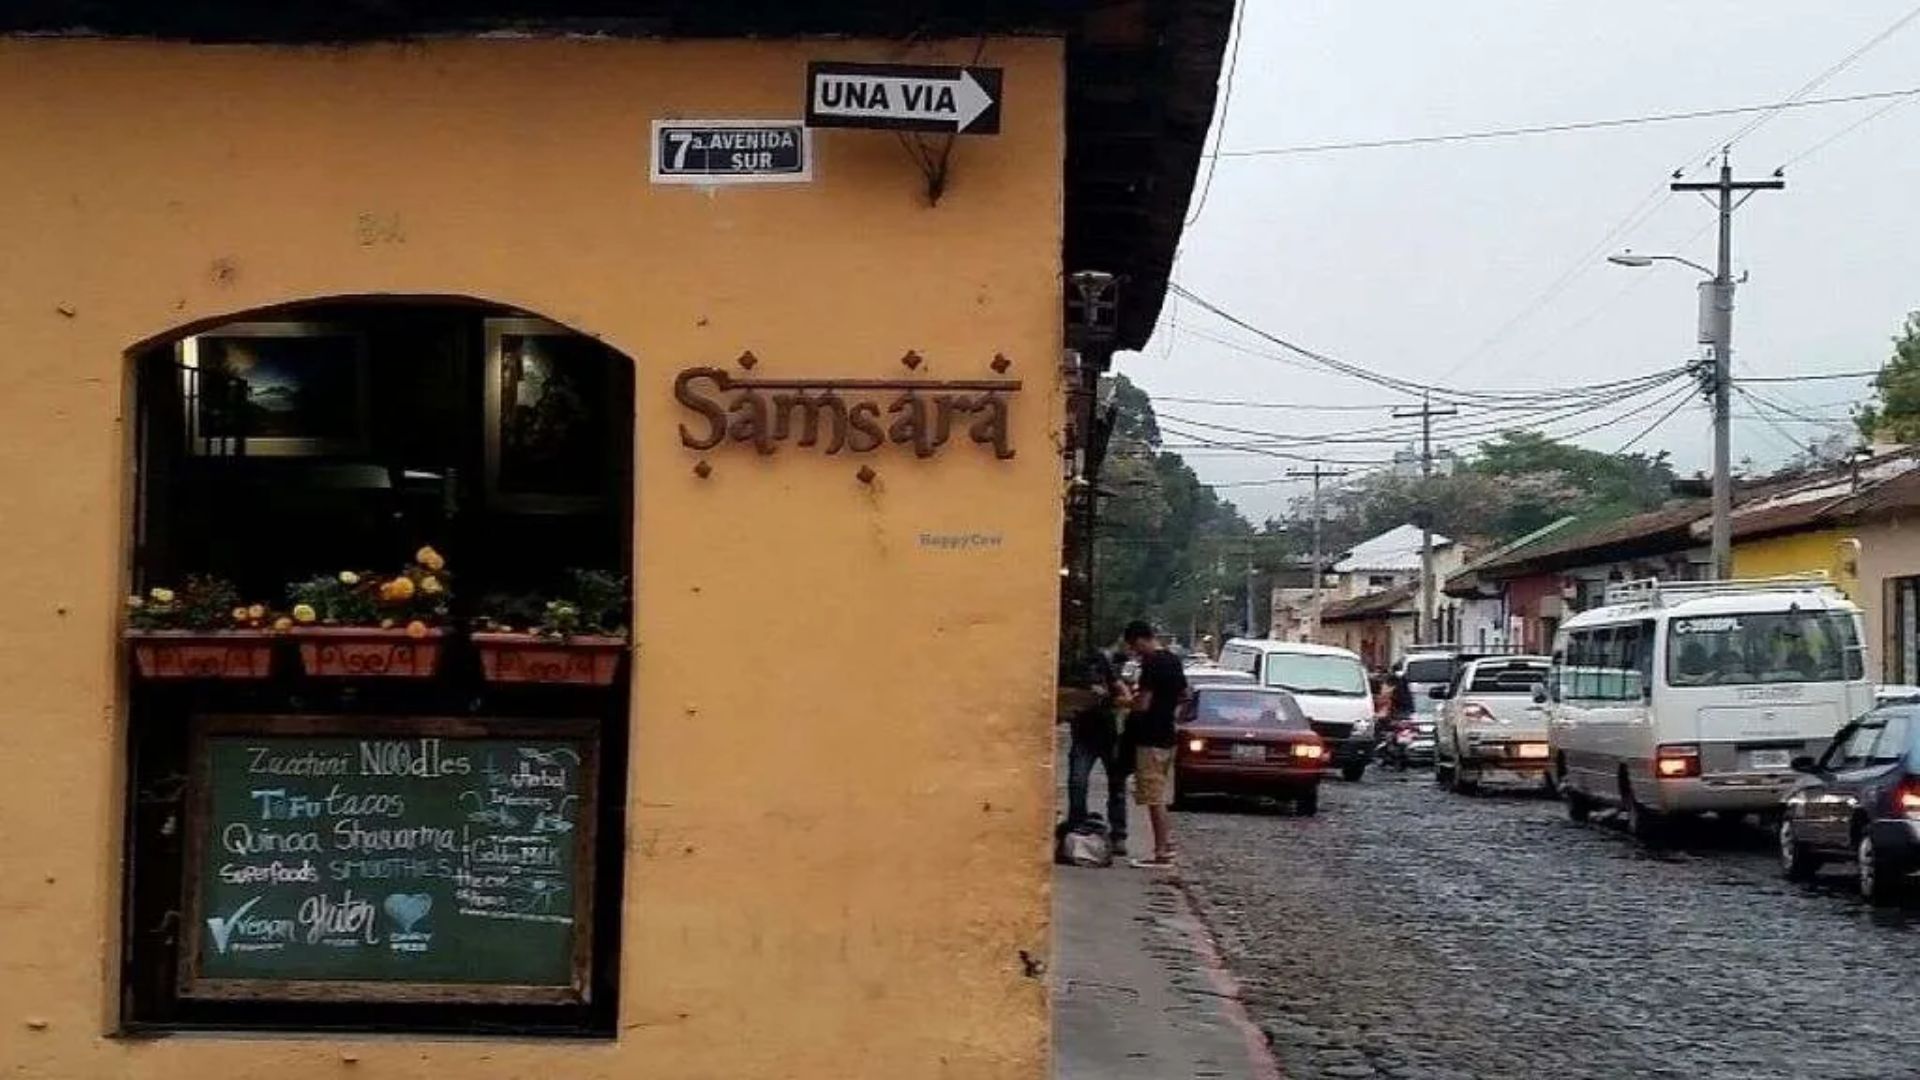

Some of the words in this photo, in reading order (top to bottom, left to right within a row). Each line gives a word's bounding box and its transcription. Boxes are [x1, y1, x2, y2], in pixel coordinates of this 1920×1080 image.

[820, 81, 889, 110] UNA
[901, 84, 957, 113] VIA
[710, 132, 794, 149] AVENIDA
[731, 152, 772, 169] SUR
[675, 366, 1021, 459] Samsara
[247, 747, 351, 777] Zucchini
